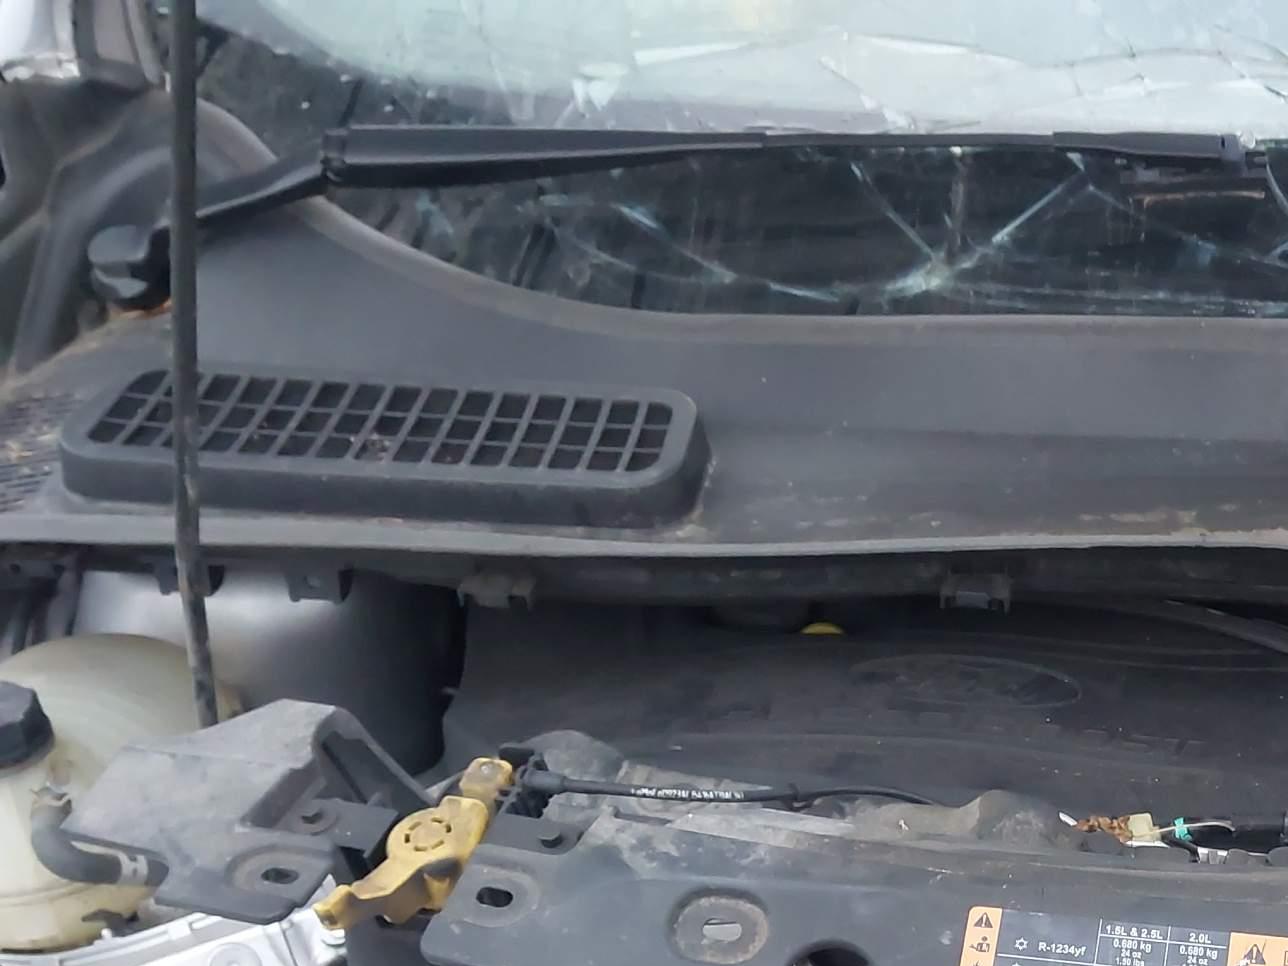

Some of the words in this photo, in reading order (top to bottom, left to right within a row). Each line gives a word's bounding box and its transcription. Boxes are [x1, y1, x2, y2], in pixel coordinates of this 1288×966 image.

[1130, 928, 1138, 936] &
[1141, 929, 1163, 939] 2.5L
[1190, 933, 1211, 943] 2.0L
[1038, 941, 1086, 957] R-1234yf
[1114, 939, 1137, 949] 0.680
[1140, 943, 1151, 953] kg
[1121, 949, 1130, 957] 24
[1180, 946, 1204, 956] 0.680
[1206, 949, 1217, 959] kg
